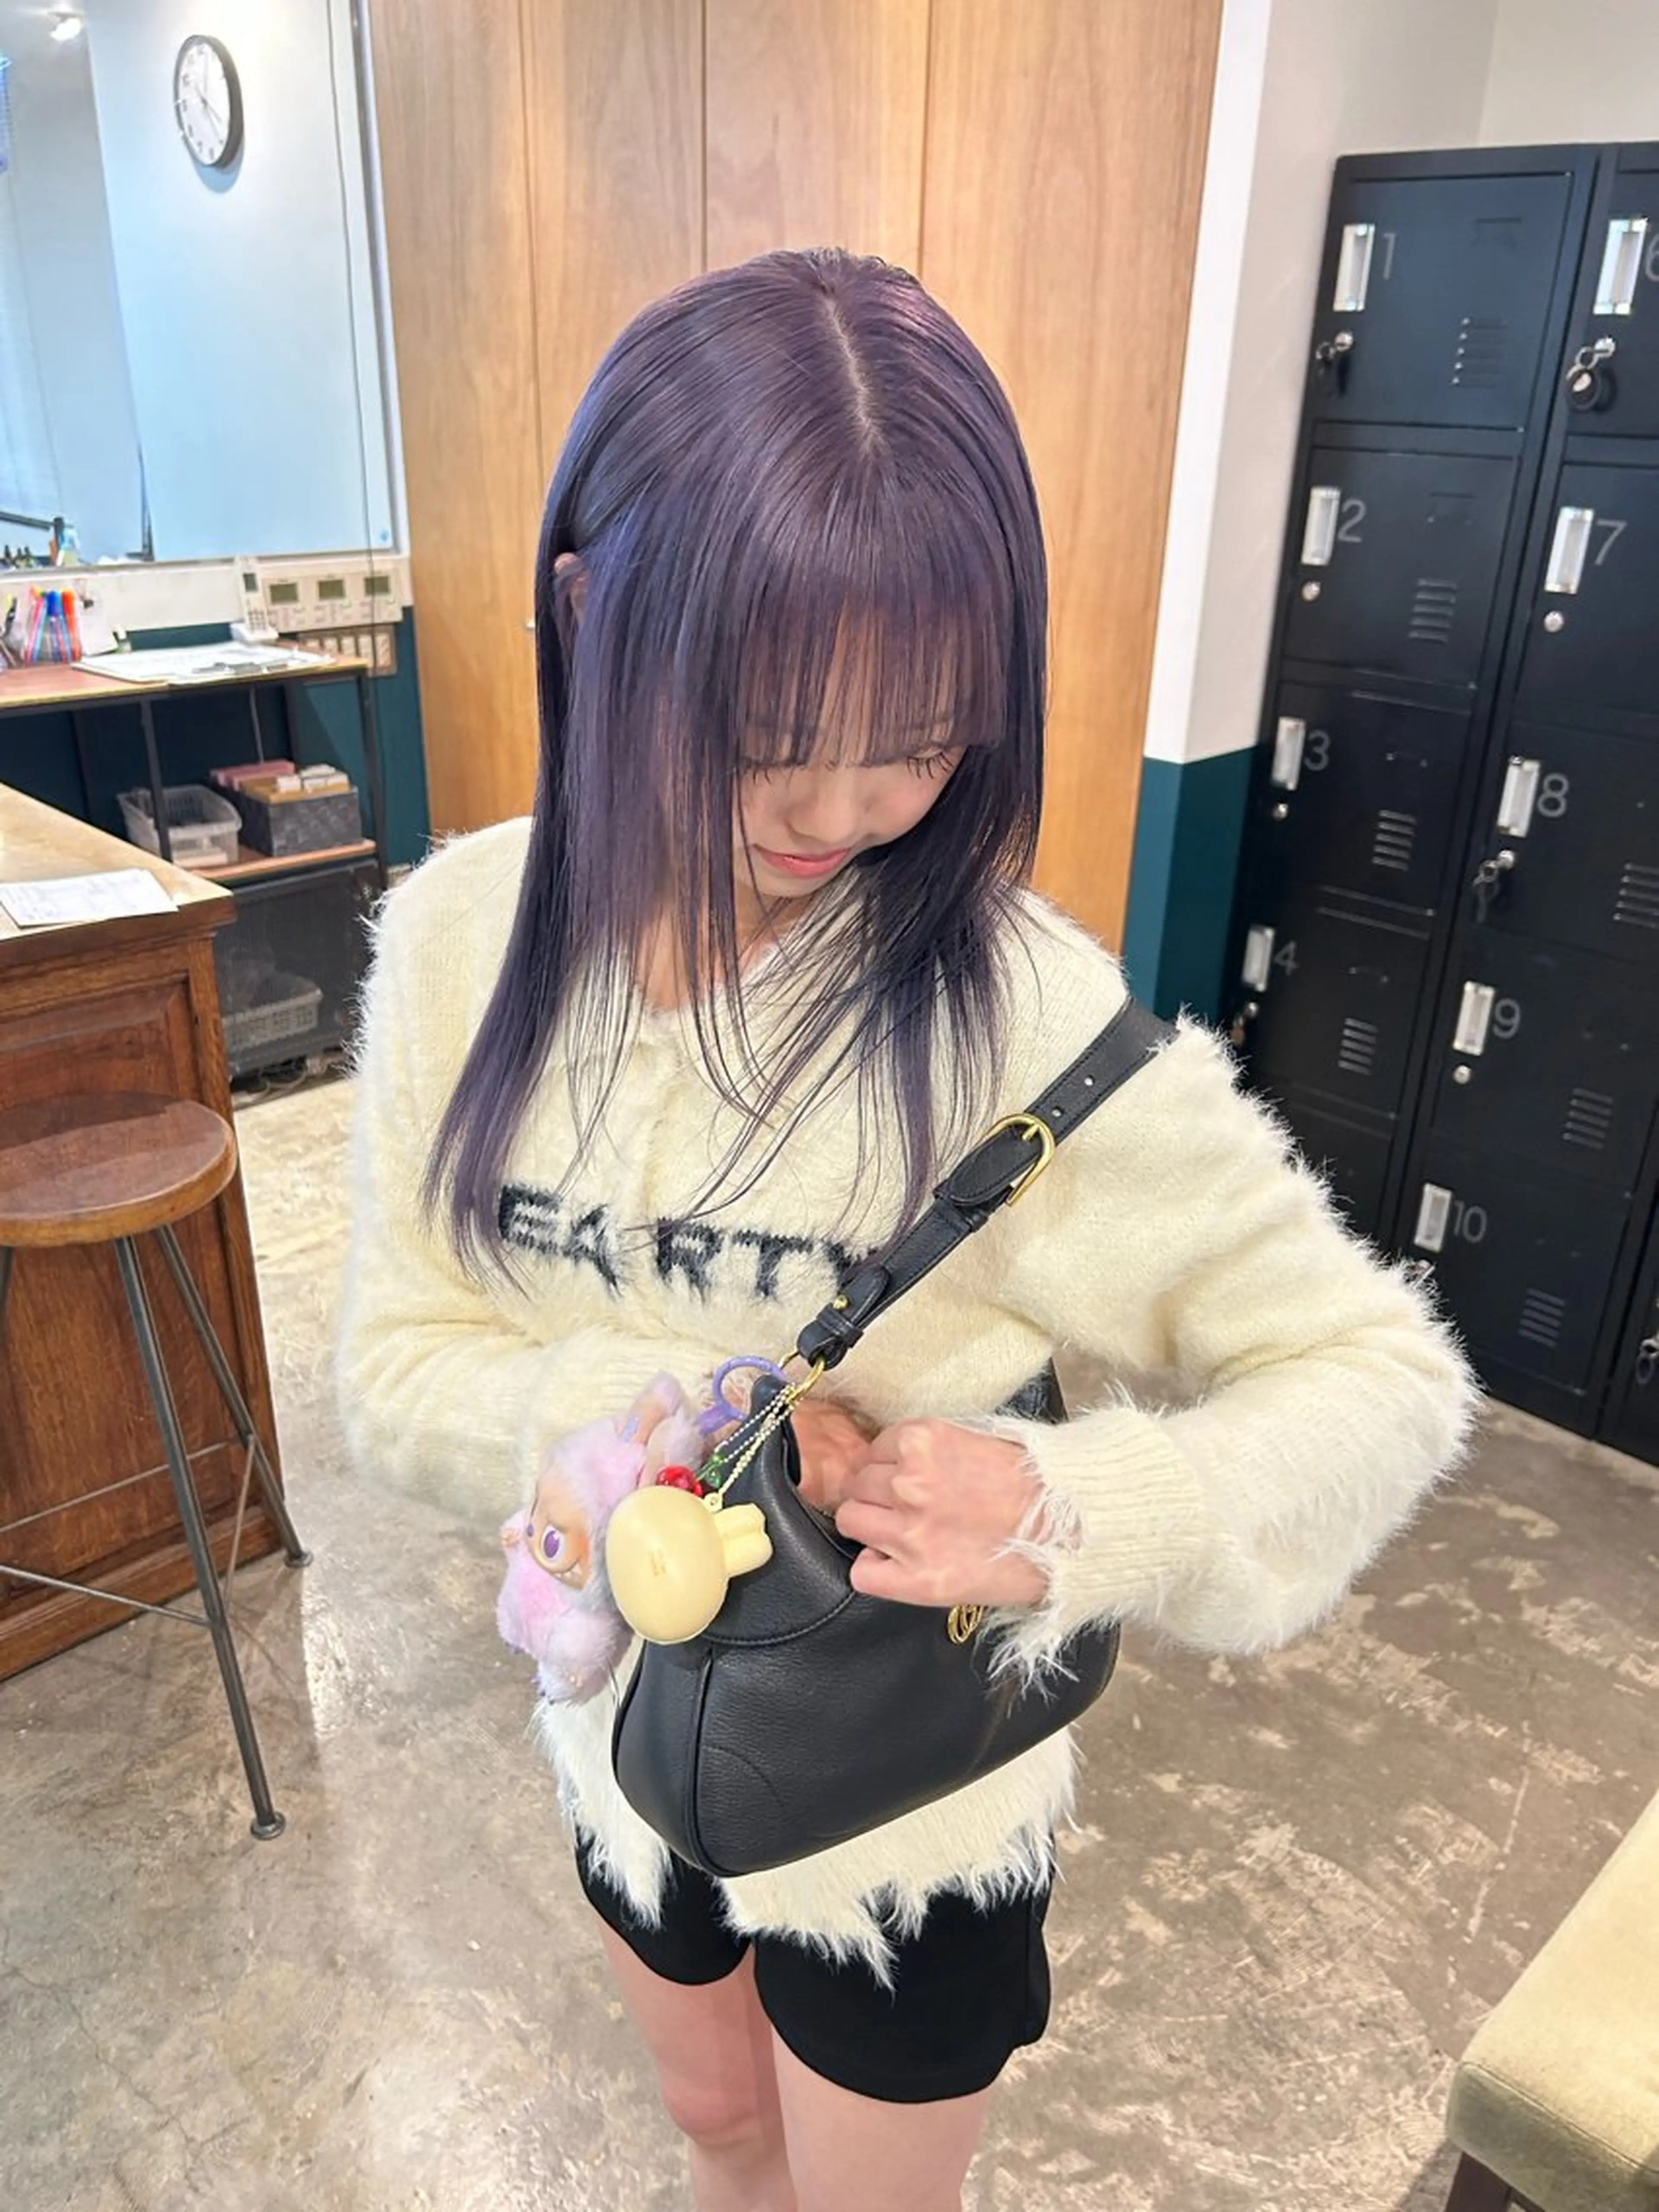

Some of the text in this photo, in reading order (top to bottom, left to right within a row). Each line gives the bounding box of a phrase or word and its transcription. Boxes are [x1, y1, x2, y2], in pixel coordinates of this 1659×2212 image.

[1383, 232, 1396, 280] 1
[1338, 499, 1366, 543] 2
[1595, 518, 1628, 565] 7
[1304, 730, 1330, 770] 3
[1537, 773, 1568, 817] 8
[1273, 941, 1297, 976] 4
[1494, 998, 1520, 1038] 9
[1454, 1200, 1487, 1243] 10
